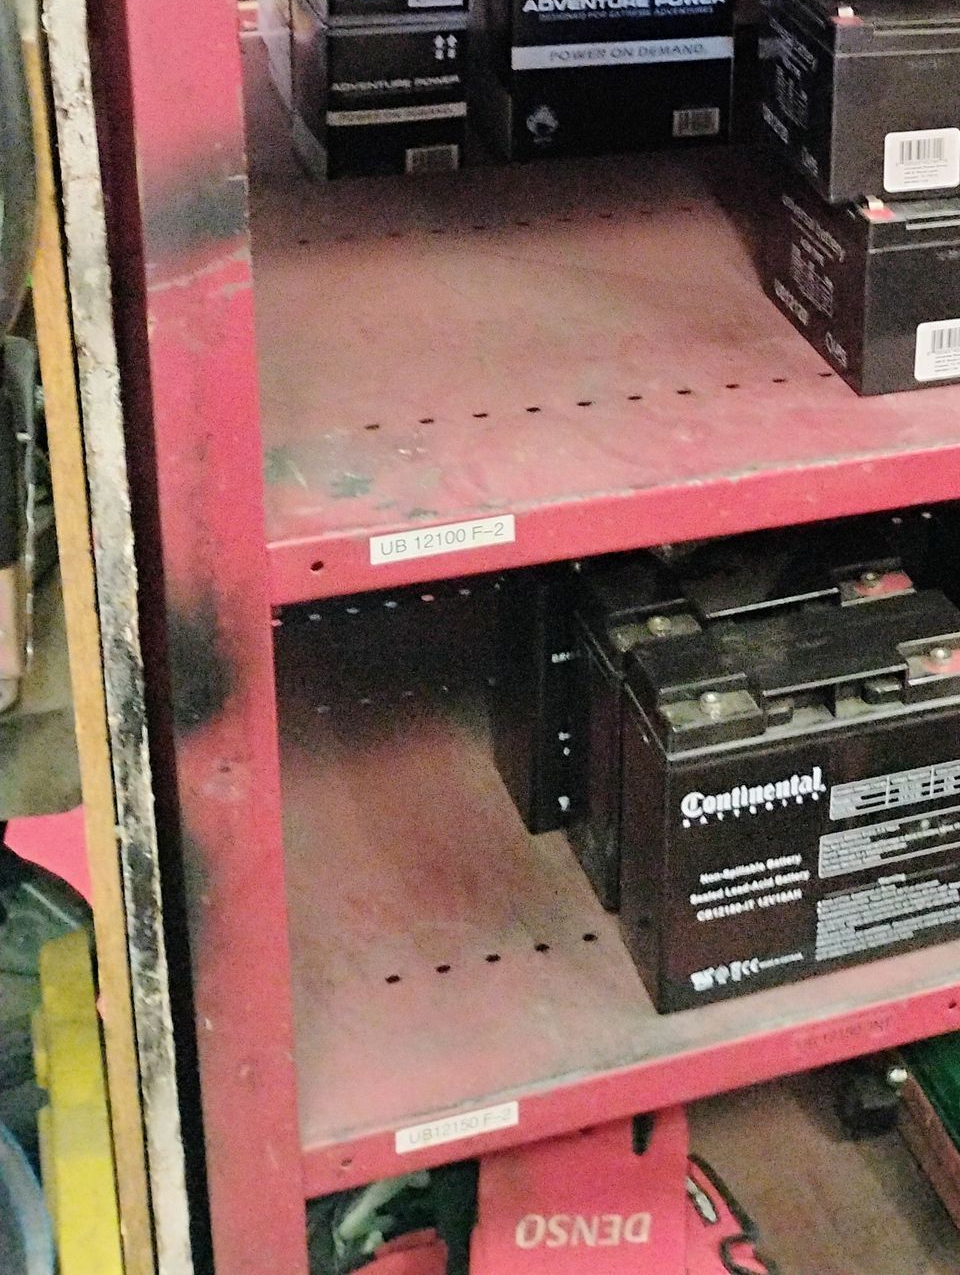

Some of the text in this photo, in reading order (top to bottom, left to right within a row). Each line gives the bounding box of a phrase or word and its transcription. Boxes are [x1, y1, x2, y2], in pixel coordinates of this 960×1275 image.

[550, 43, 705, 62] POWER ON DEMAND
[381, 522, 505, 556] UB 12100 F-2
[681, 766, 826, 819] Continental
[409, 1108, 512, 1144] UB12150 F-2
[515, 1212, 653, 1250] DENSO
